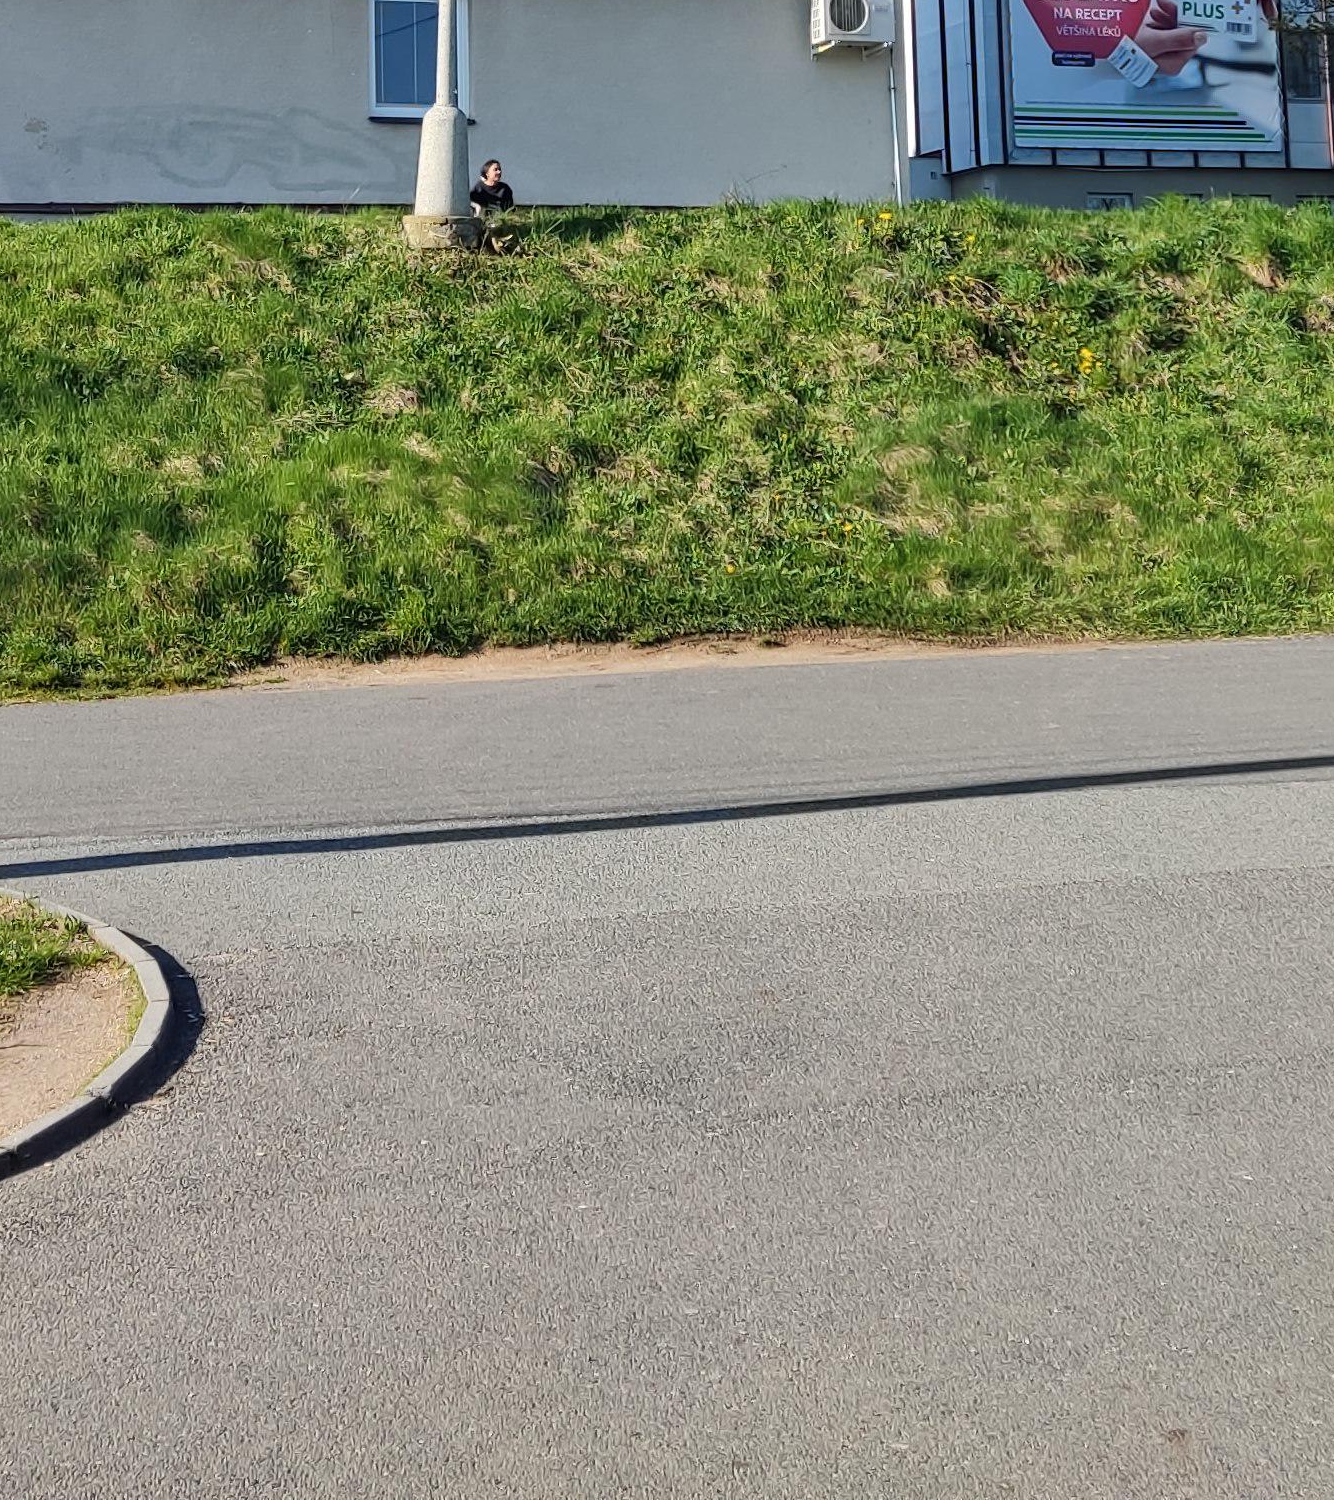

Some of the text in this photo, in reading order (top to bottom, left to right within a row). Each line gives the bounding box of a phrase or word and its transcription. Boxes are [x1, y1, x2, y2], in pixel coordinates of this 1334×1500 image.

[1053, 7, 1123, 21] NA RECEPT
[1182, 1, 1225, 20] PLUS
[1097, 25, 1121, 38] LÉKŮ
